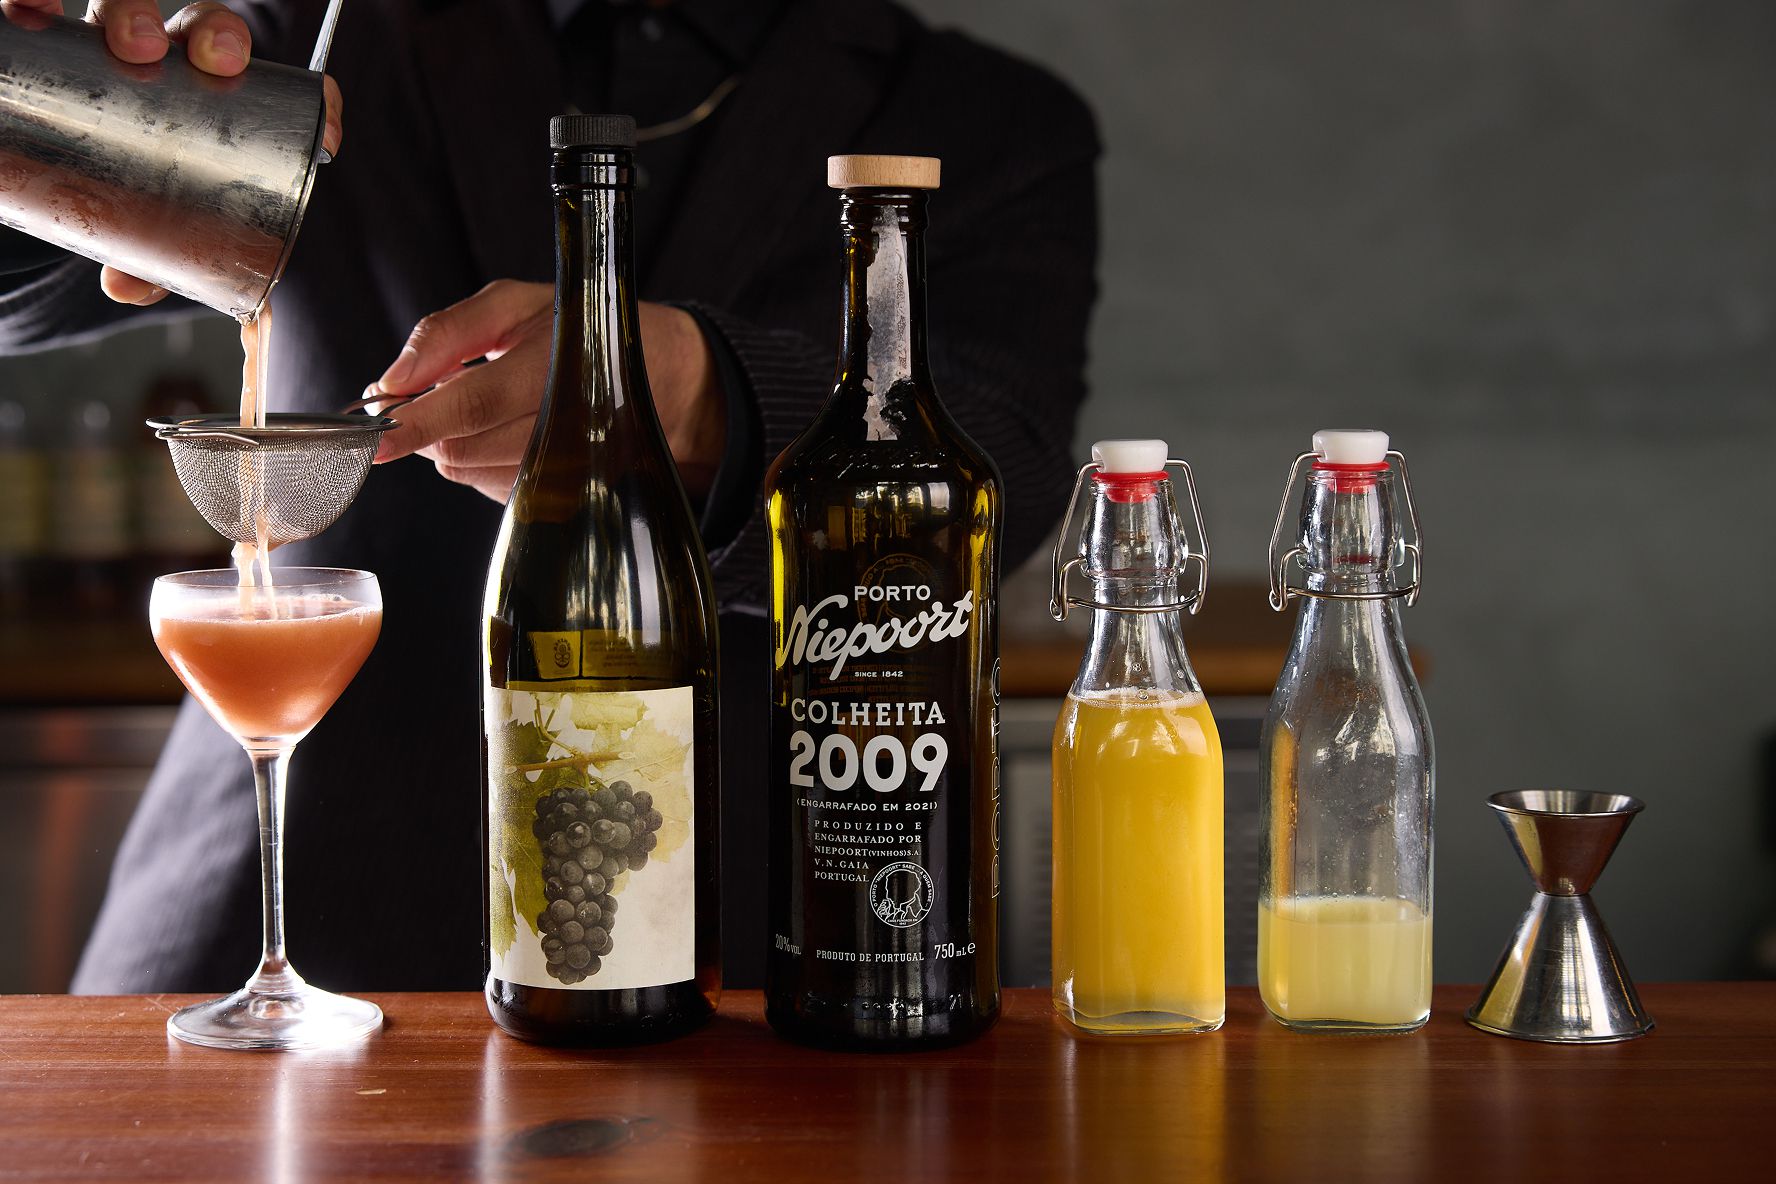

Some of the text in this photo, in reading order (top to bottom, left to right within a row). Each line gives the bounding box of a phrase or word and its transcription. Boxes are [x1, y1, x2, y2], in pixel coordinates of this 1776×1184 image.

[854, 585, 931, 601] PORTO
[775, 589, 973, 681] Niepoort
[855, 671, 903, 679] SINCE 1842
[791, 698, 945, 726] COLHEITA
[790, 730, 948, 792] 2009
[796, 798, 938, 812] (ENGARRAFADO EM 2021)
[814, 819, 922, 831] PRODUZIDO E
[814, 833, 921, 844] ENGARRAFADO POR
[814, 871, 870, 882] PORTUGAL
[816, 950, 925, 963] PRODUTO DE PORTUGAL
